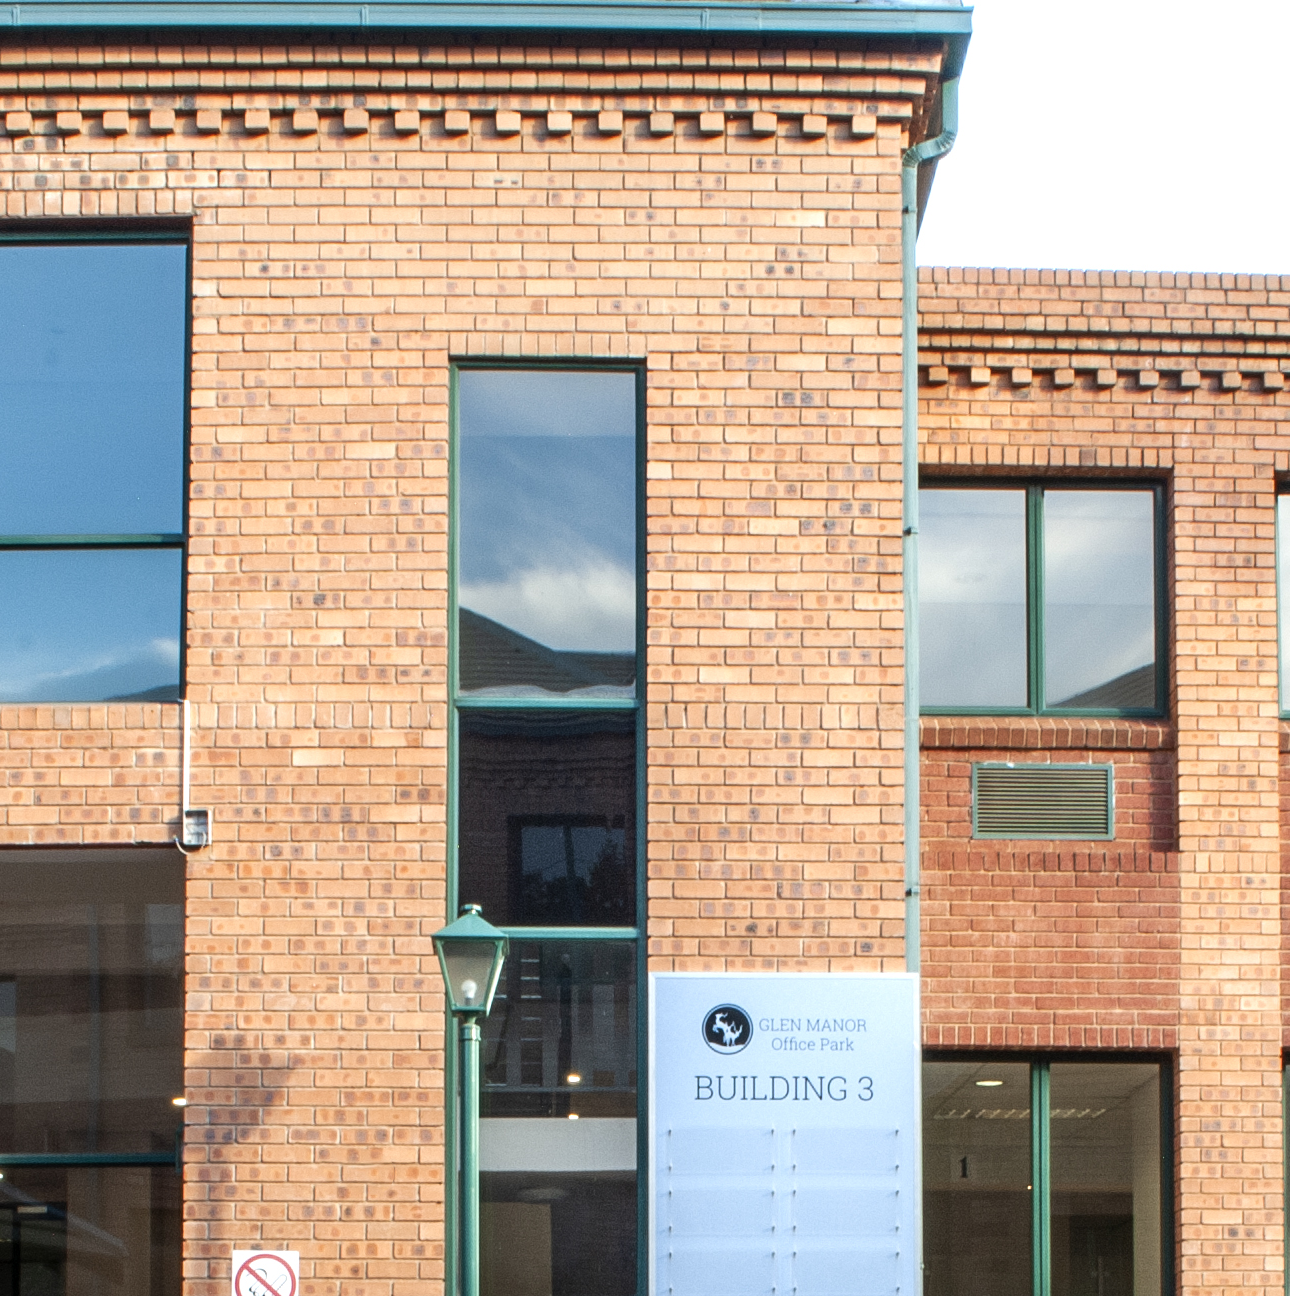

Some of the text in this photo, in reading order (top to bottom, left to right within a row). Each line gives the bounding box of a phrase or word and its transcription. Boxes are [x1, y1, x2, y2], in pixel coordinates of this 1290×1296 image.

[758, 1018, 867, 1033] GLEN MANOR
[771, 1037, 855, 1051] Office Park
[694, 1075, 874, 1101] BUILDING 3
[959, 1156, 968, 1178] 1
